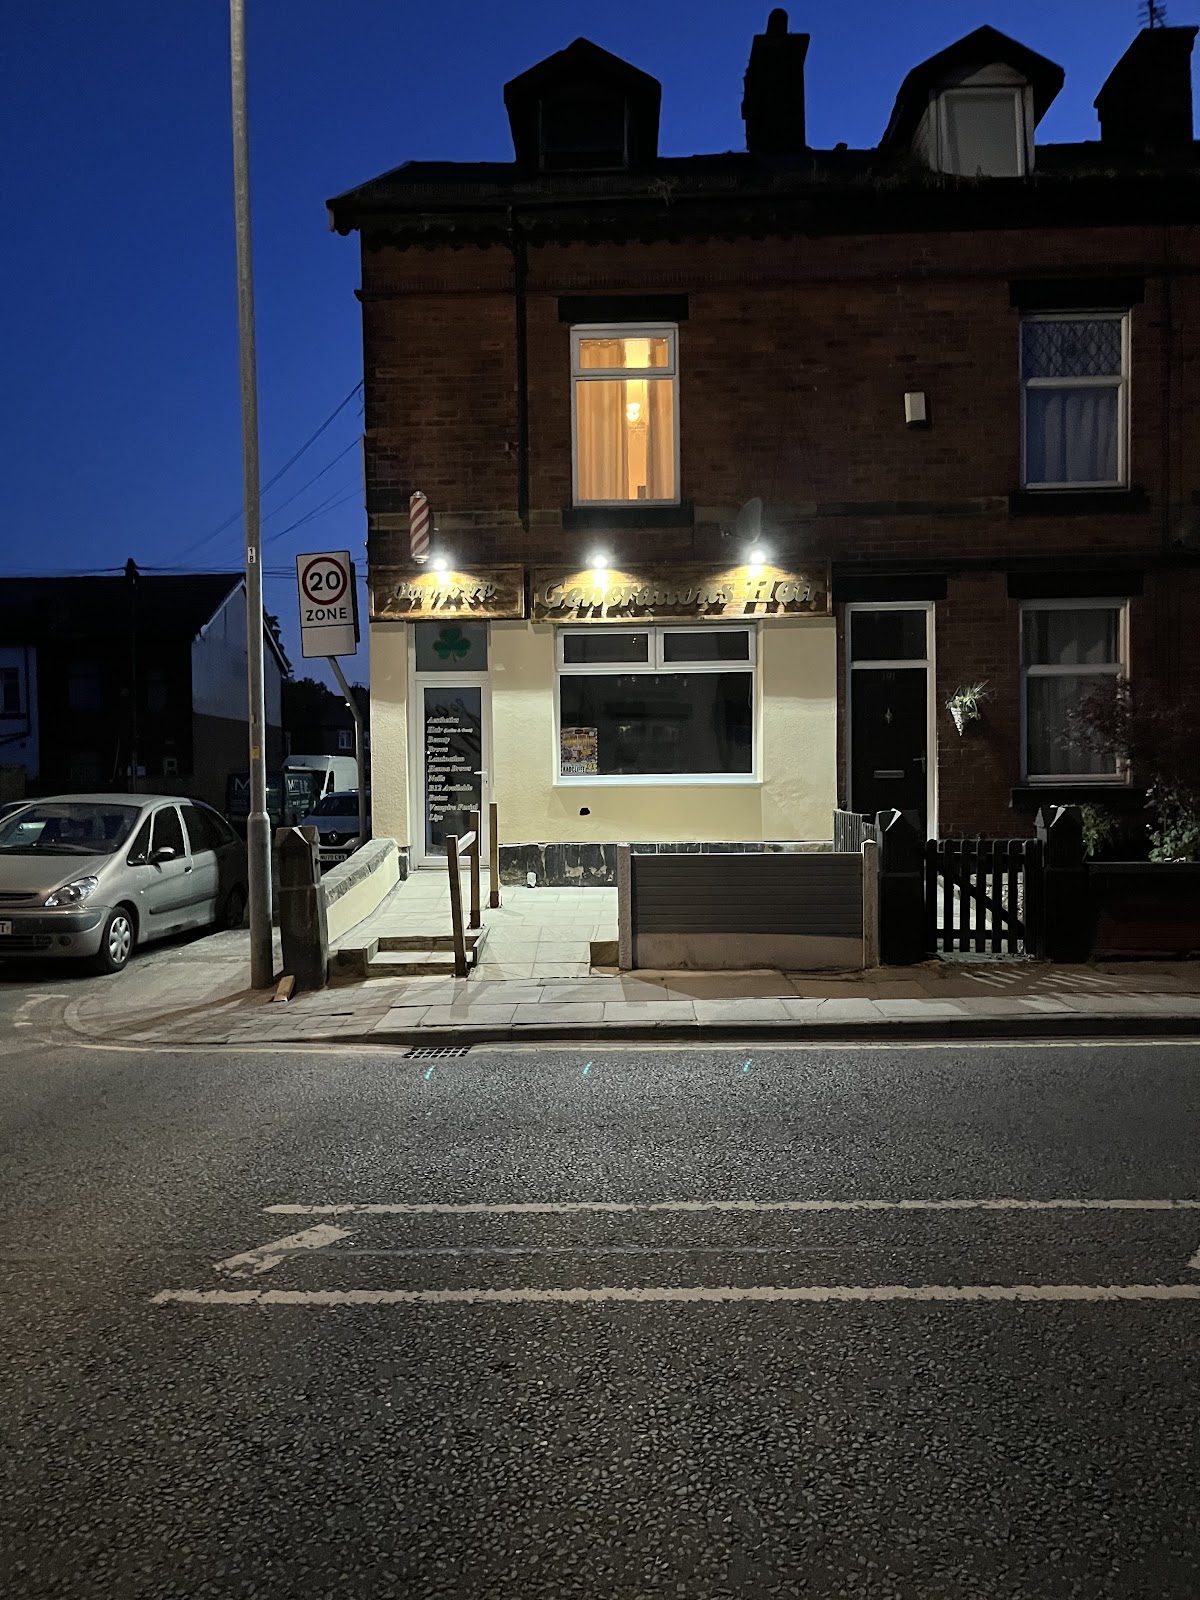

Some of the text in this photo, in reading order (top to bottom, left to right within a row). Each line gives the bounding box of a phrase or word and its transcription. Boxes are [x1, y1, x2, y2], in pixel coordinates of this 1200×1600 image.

[309, 571, 341, 592] 20
[538, 572, 822, 609] Generations Hair
[306, 607, 348, 621] ZONE
[427, 736, 450, 744] Beauty
[428, 783, 473, 792] B12 Available
[428, 794, 449, 802] Botox
[429, 803, 478, 812] Vampire Facial
[429, 814, 443, 822] Lips
